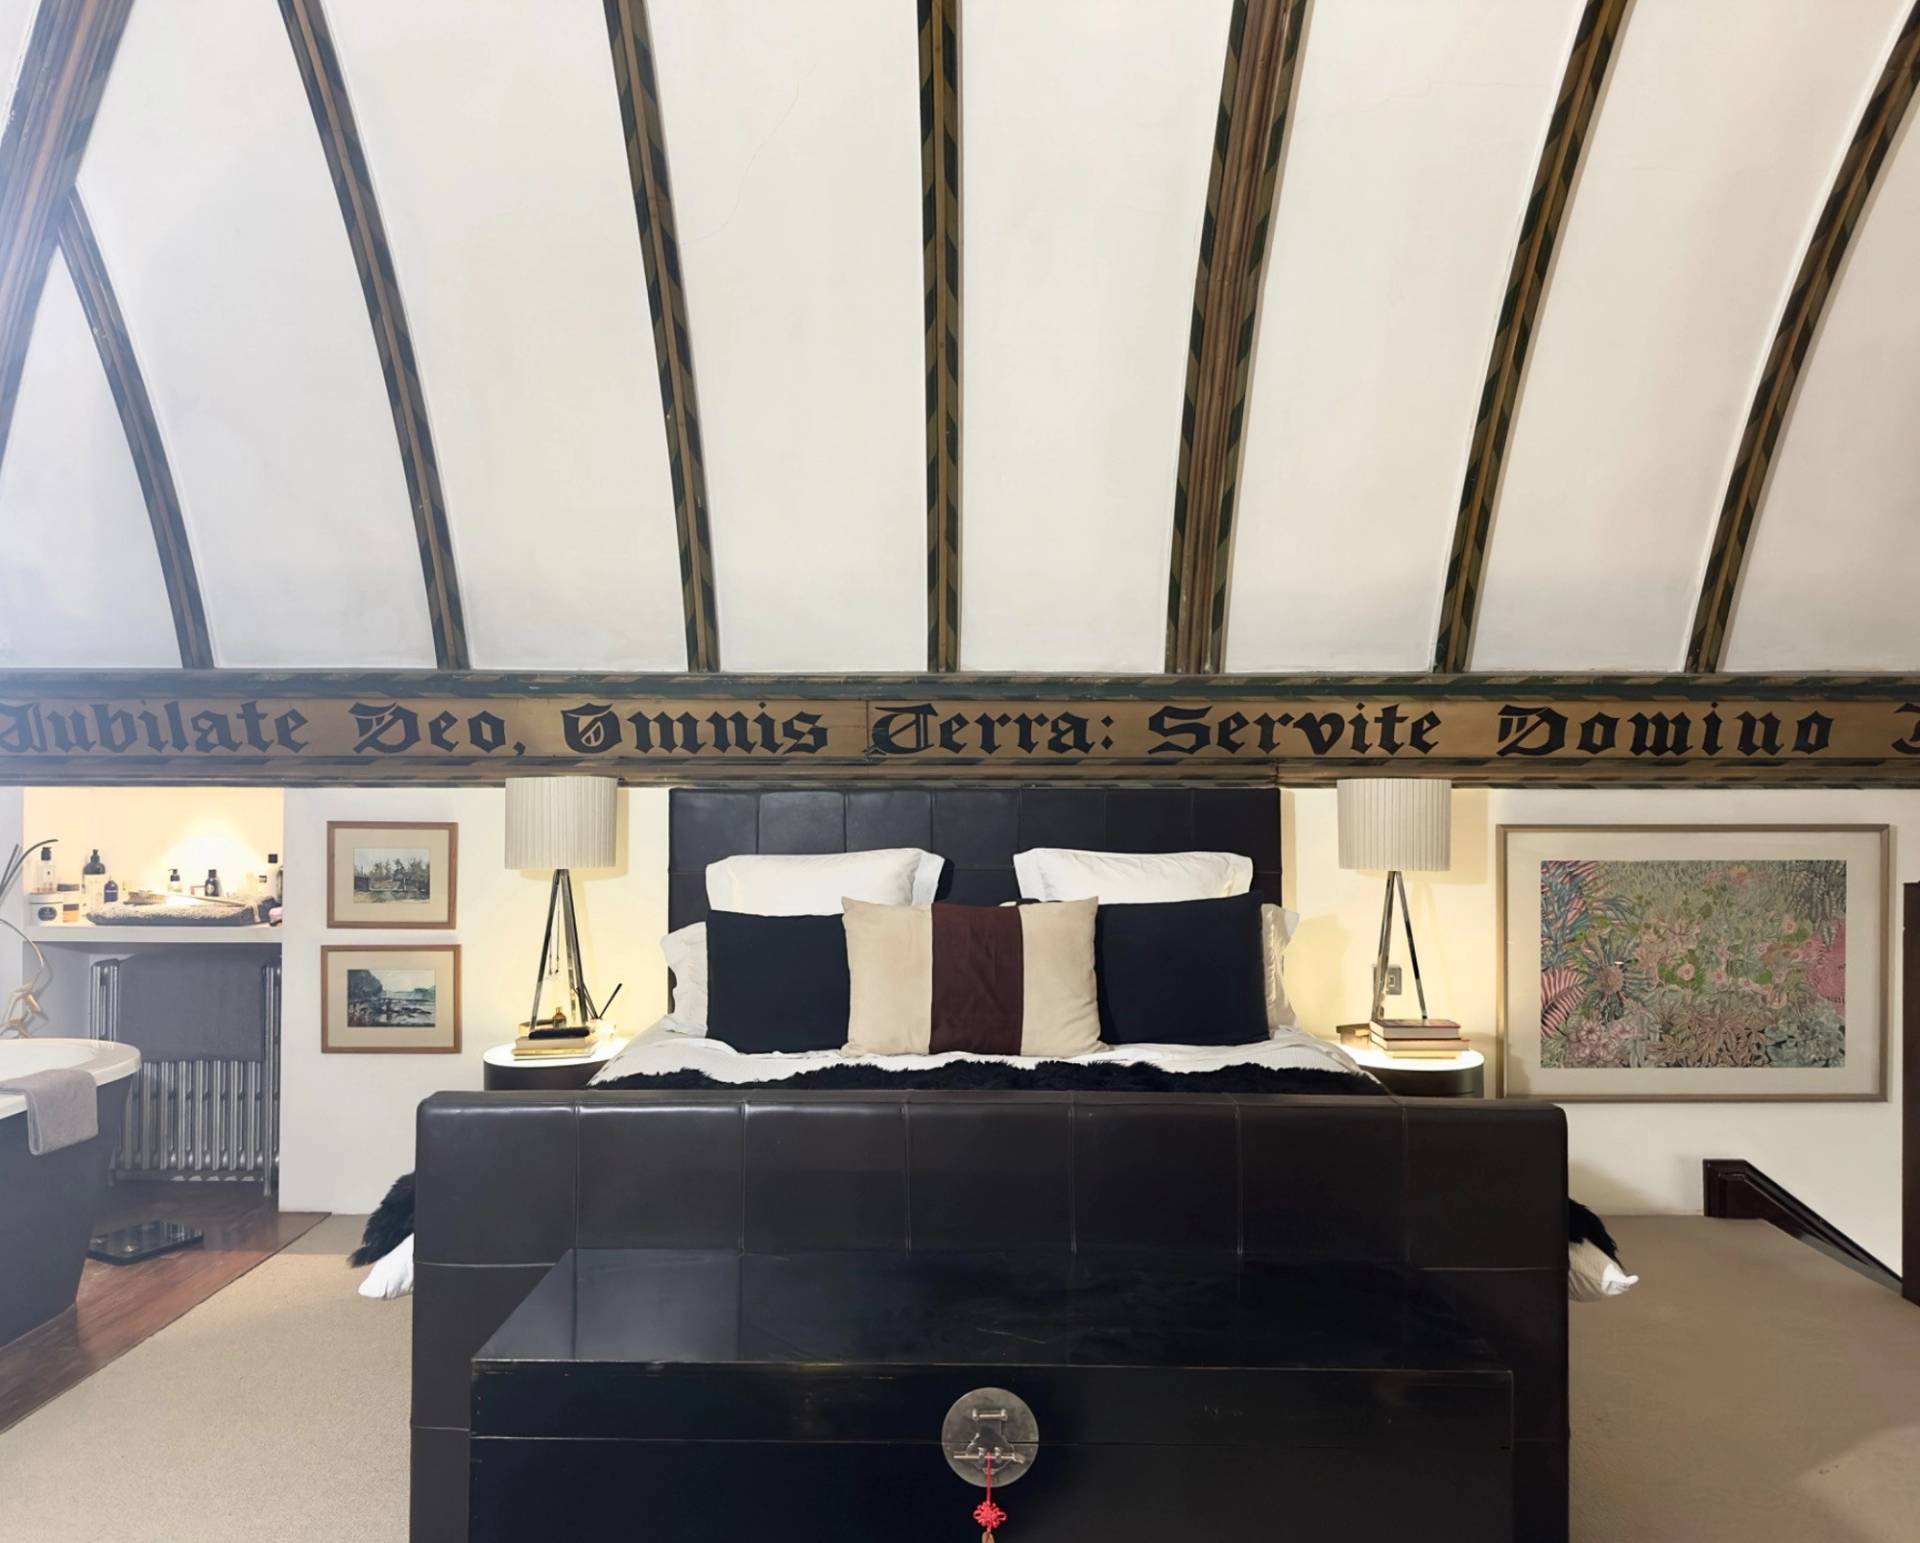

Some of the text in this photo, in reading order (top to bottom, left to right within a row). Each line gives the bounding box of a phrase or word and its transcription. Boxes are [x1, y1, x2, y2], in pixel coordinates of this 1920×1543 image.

[348, 702, 526, 754] Deo,
[560, 702, 829, 754] Omnis
[863, 703, 1115, 754] Terra:
[1148, 703, 1441, 756] Servite
[1496, 703, 1835, 756] Domino
